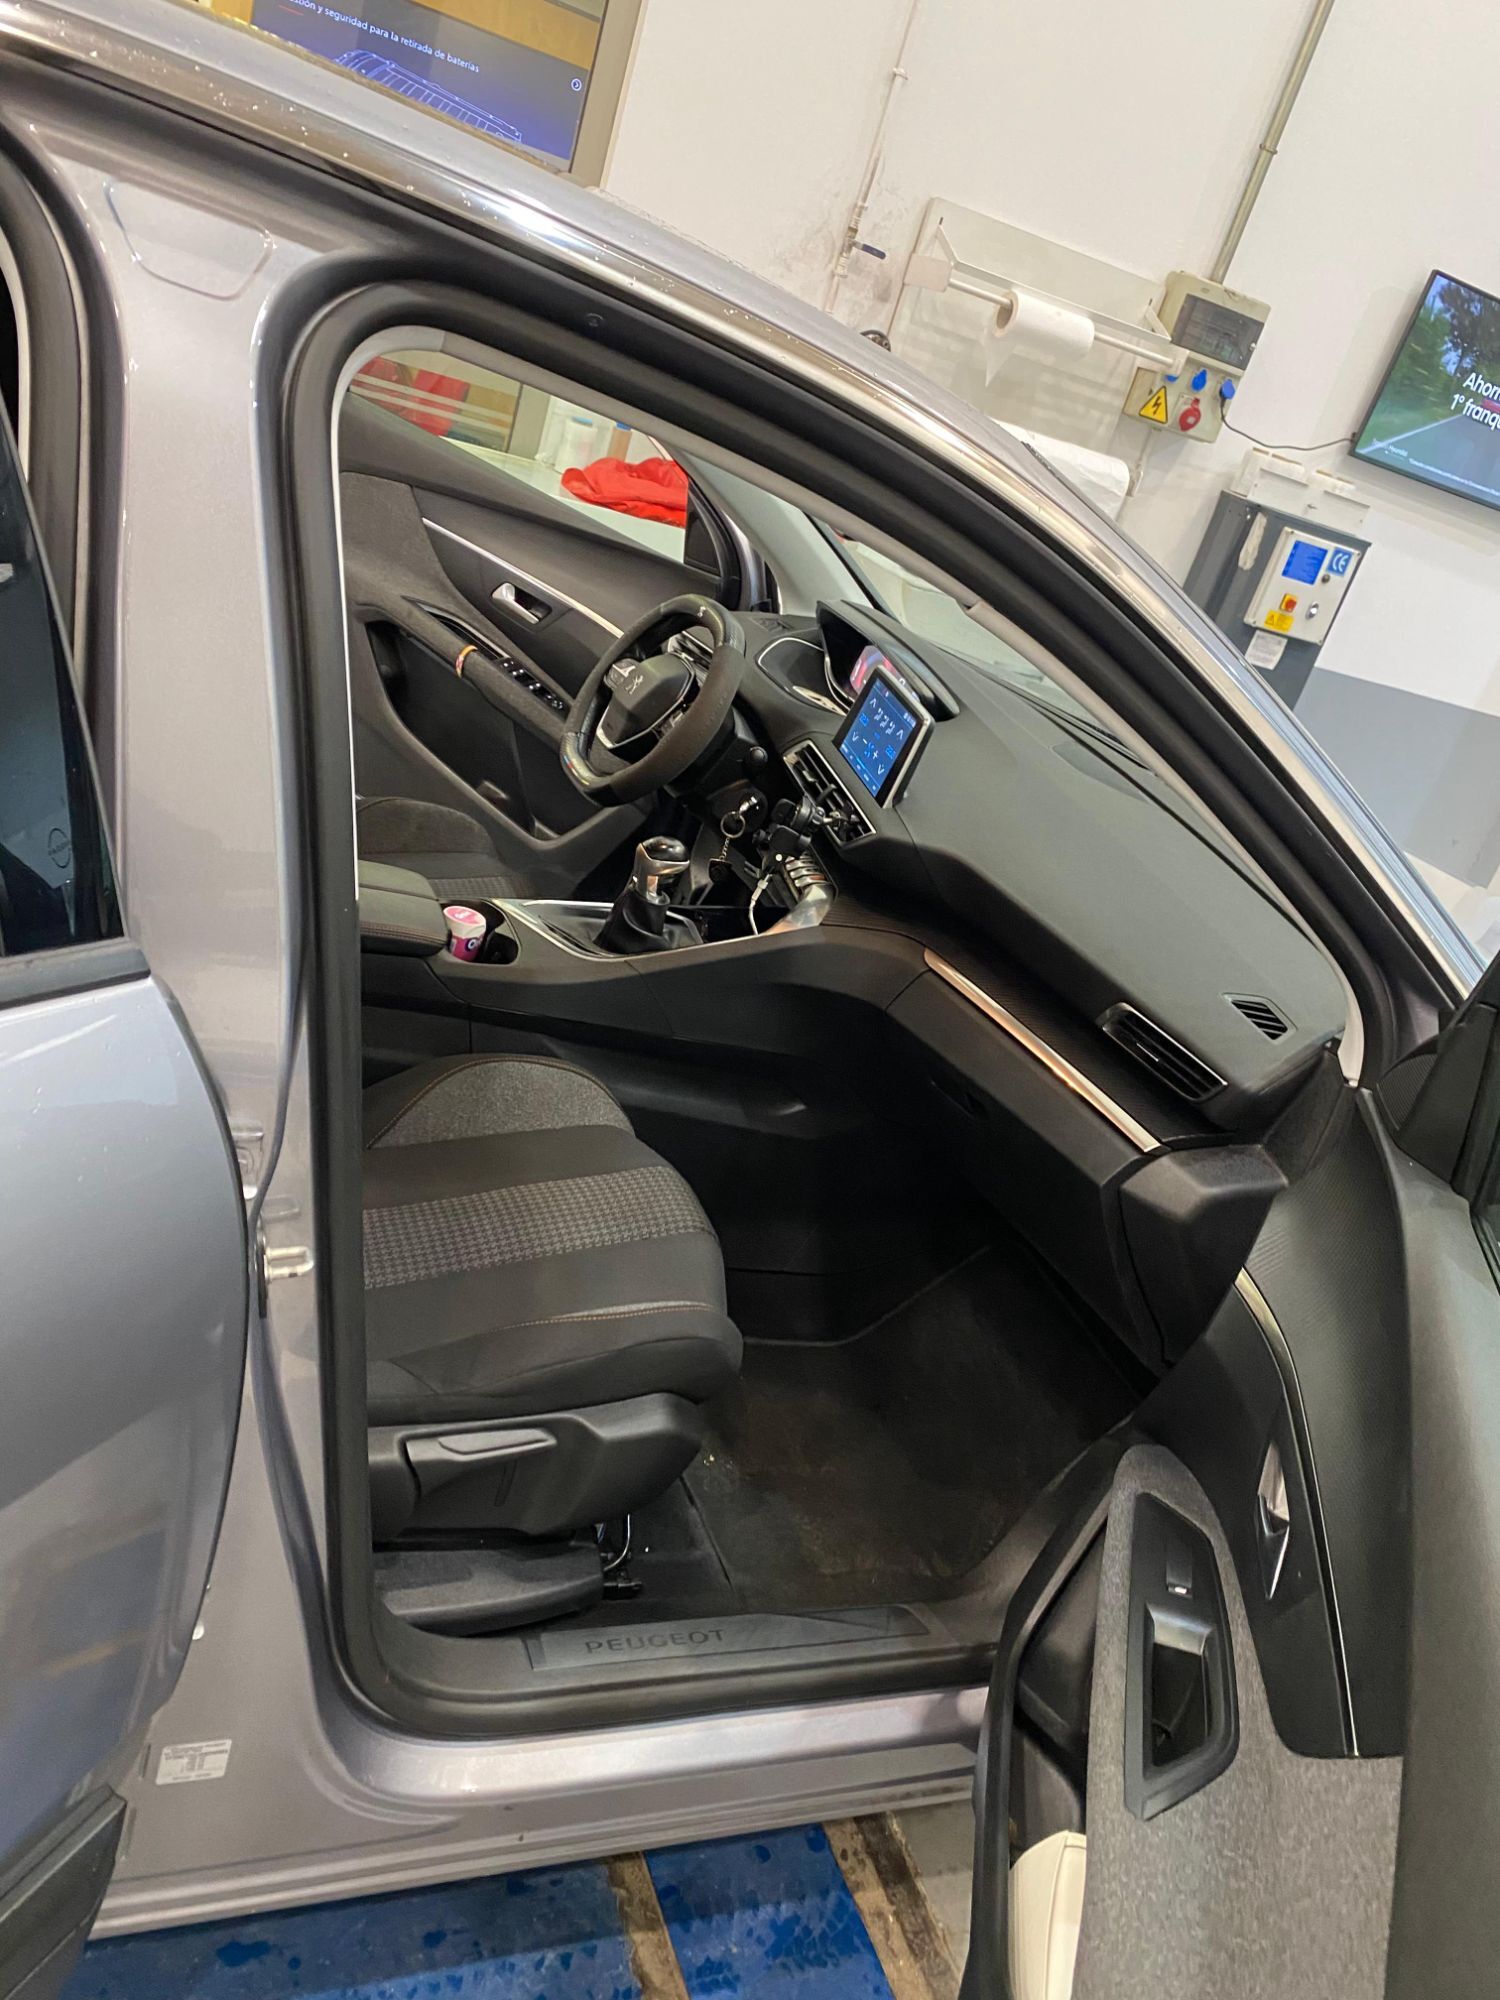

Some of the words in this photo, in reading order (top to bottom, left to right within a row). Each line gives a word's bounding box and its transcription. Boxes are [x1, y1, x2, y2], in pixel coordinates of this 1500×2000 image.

[316, 6, 323, 14] y
[324, 8, 369, 30] seguridad
[369, 25, 389, 38] para
[390, 31, 399, 42] la
[400, 36, 433, 55] retirada
[434, 48, 445, 60] de
[585, 1629, 724, 1654] PEUGEOT
